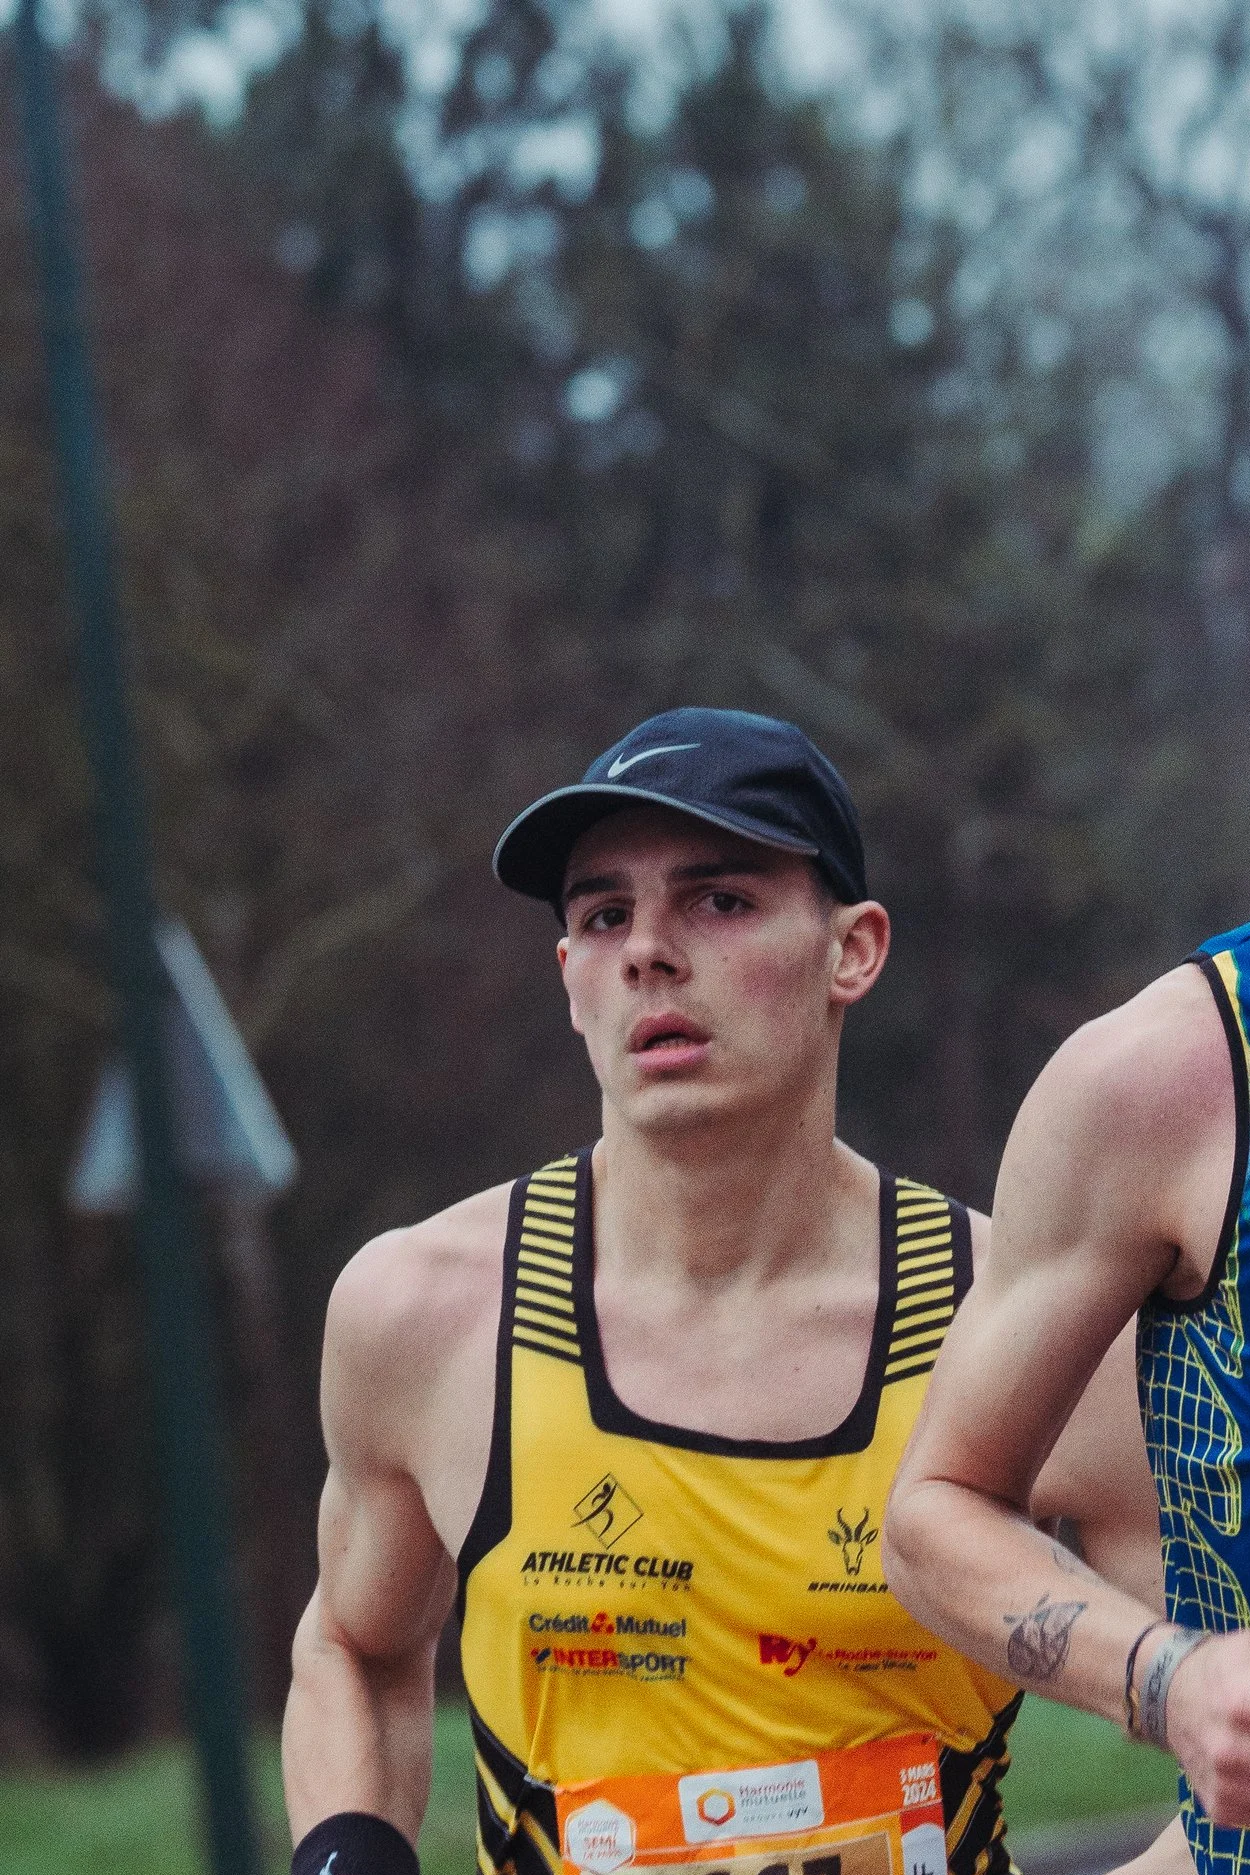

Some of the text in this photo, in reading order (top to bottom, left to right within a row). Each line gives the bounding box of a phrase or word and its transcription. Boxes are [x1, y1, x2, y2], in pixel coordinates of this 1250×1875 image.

[520, 1551, 694, 1582] ATHLETIC CLUB
[528, 1612, 687, 1638] Crédit Mutuel
[902, 1779, 938, 1806] 2024
